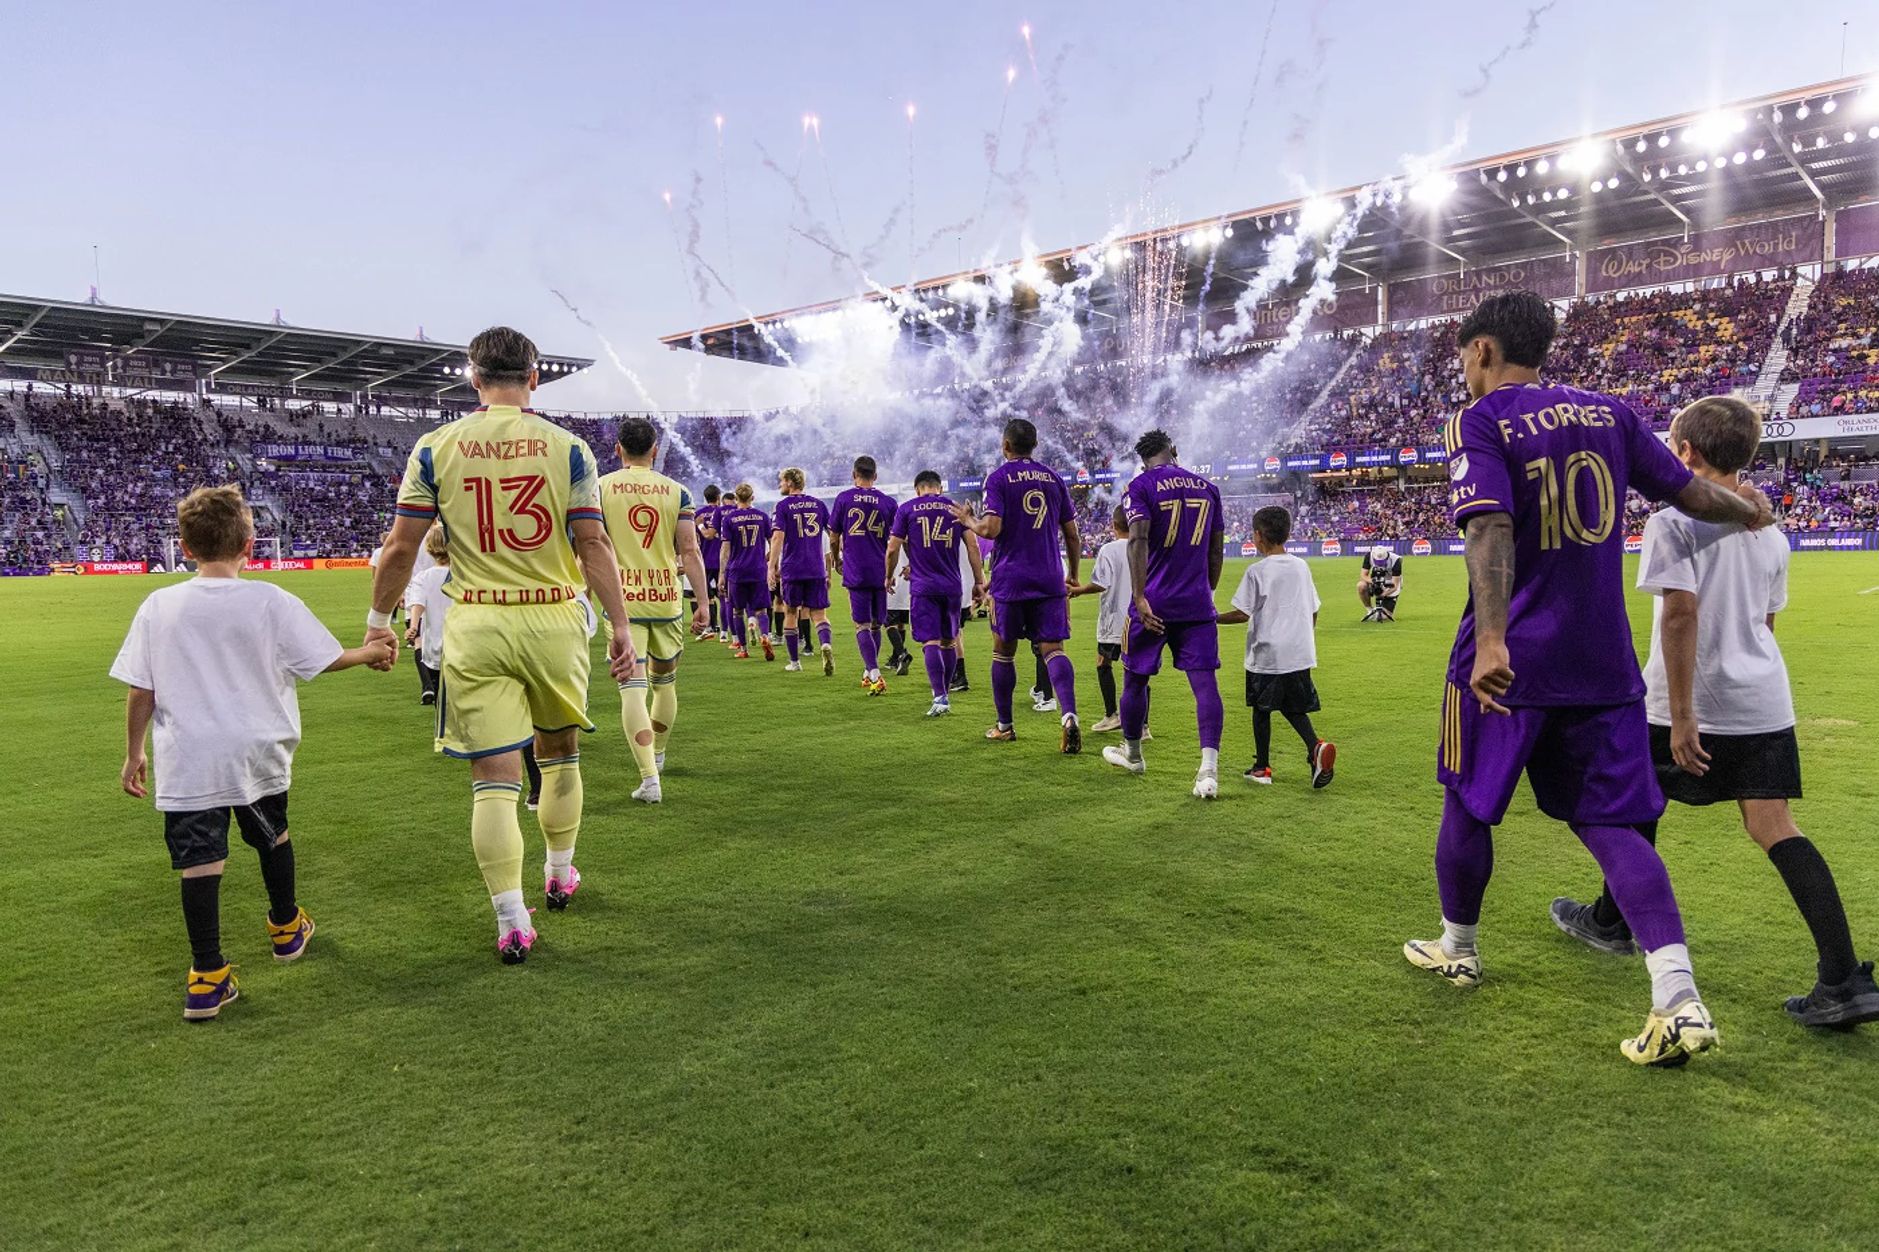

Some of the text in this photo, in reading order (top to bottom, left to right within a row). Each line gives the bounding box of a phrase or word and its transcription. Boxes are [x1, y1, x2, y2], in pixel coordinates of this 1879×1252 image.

[1736, 232, 1796, 256] World
[1433, 269, 1525, 295] ORLANDO
[37, 369, 78, 383] MAN
[268, 444, 295, 456] IRON
[299, 445, 325, 455] LION
[327, 446, 353, 458] FIRM
[458, 439, 548, 461] VANZEIR
[612, 483, 670, 496] MORGAN
[1156, 476, 1208, 492] ANGULO
[853, 494, 879, 505] SMITH
[1022, 489, 1048, 529] 9
[1525, 449, 1616, 550] 10
[463, 474, 553, 554] 13
[628, 503, 660, 550] 9
[793, 512, 820, 538] 13
[847, 507, 886, 538] 24
[1158, 497, 1211, 548] 77
[738, 524, 760, 547] 17
[916, 516, 953, 548] 14
